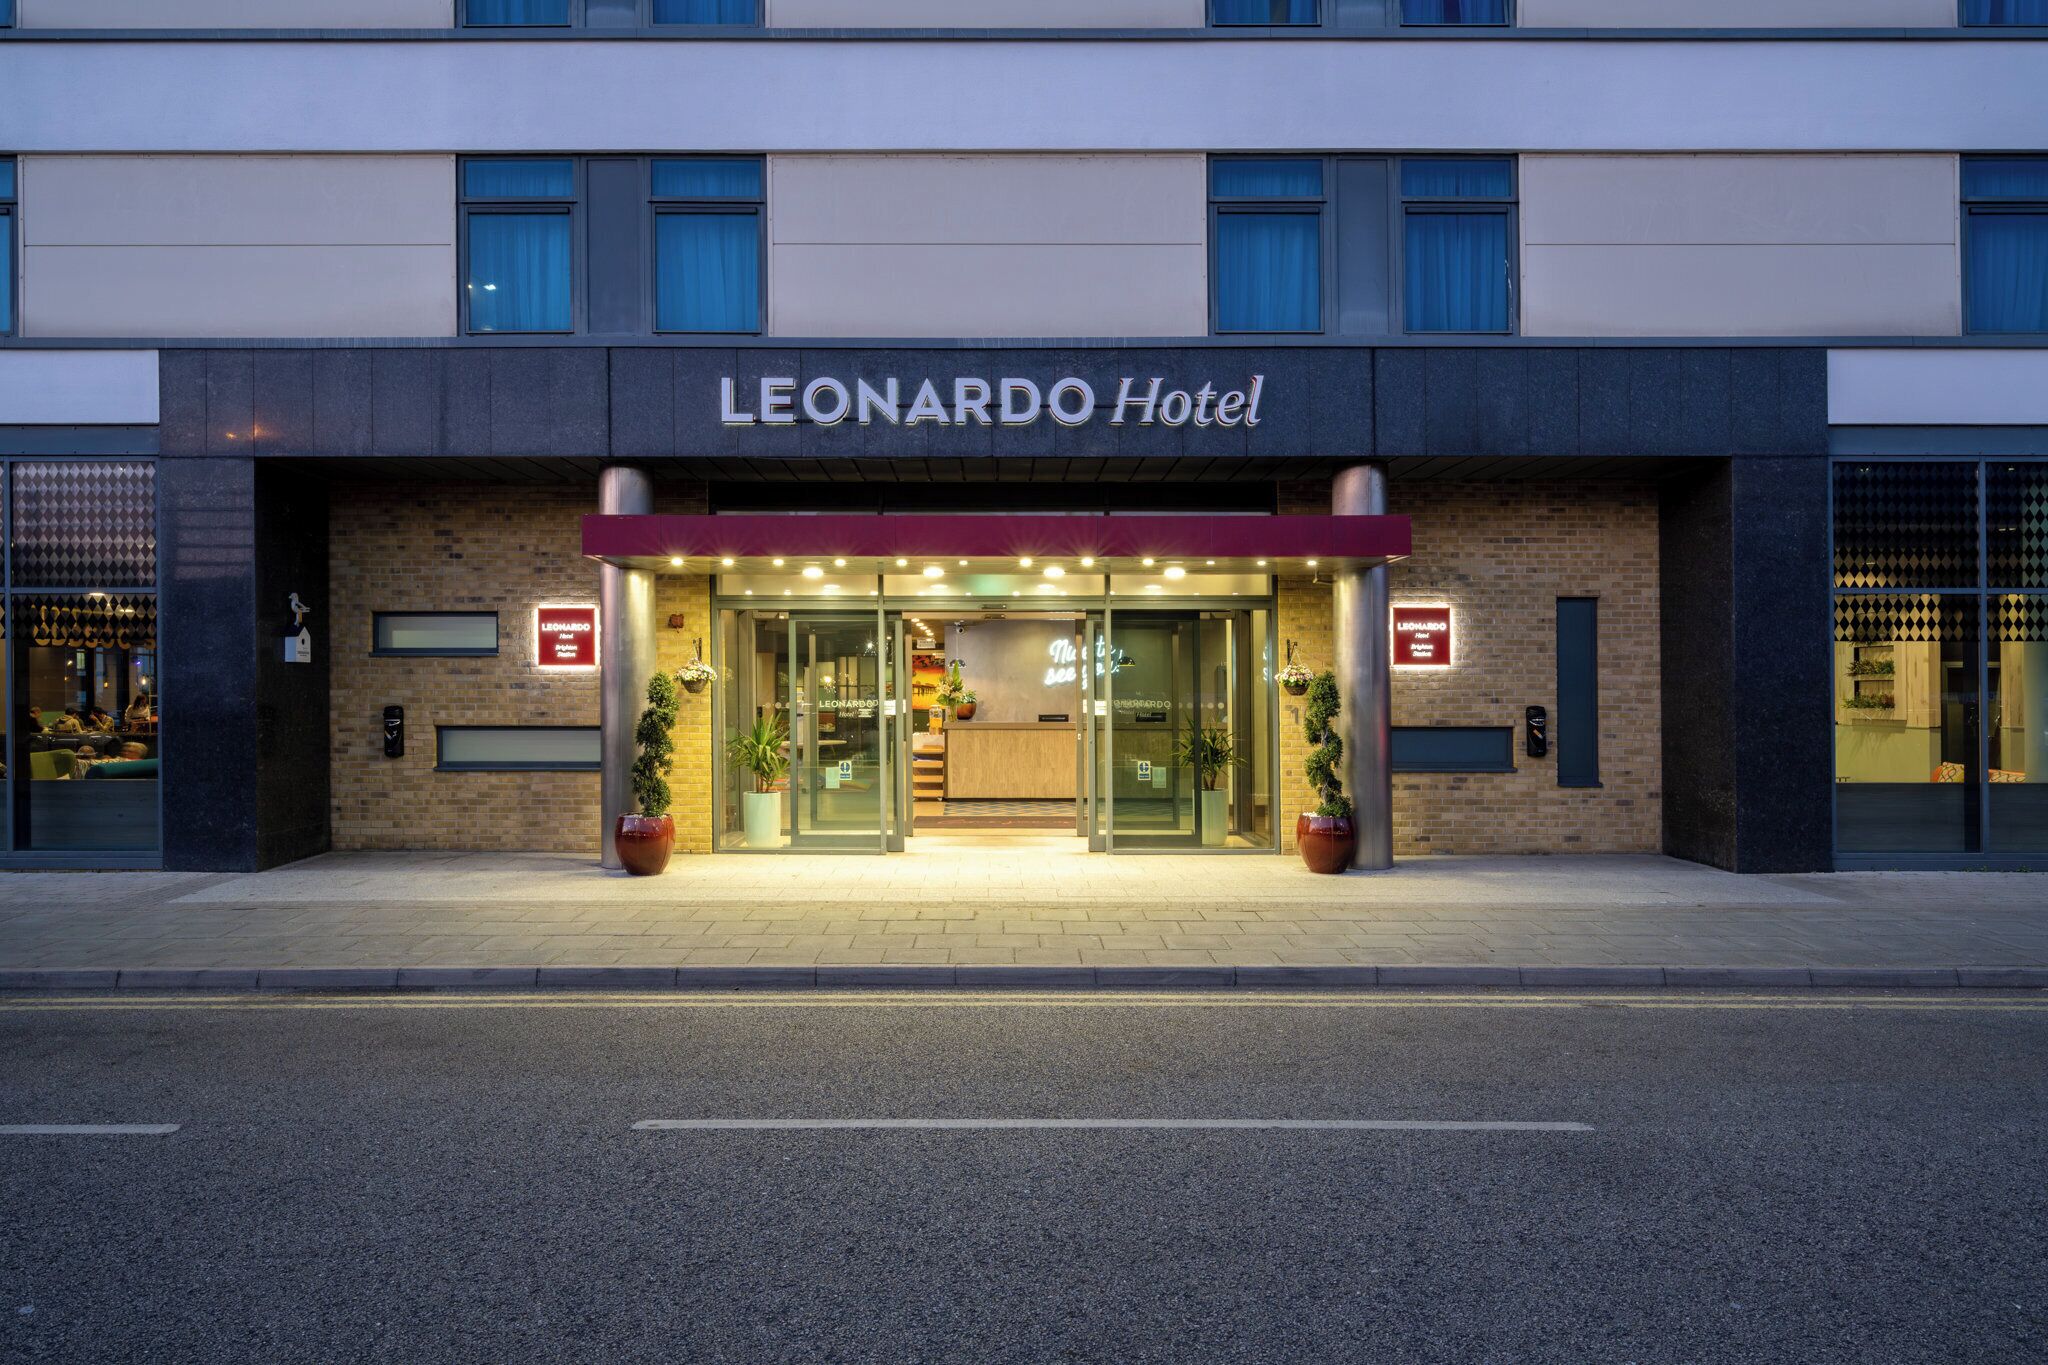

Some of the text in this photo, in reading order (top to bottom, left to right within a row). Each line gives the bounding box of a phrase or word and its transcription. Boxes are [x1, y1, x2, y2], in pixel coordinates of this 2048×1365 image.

[721, 374, 1265, 427] LEONARDO Hotel
[541, 623, 591, 631] LEONARDO
[1397, 622, 1447, 631] LEONARDO
[819, 700, 873, 708] LEONARDO
